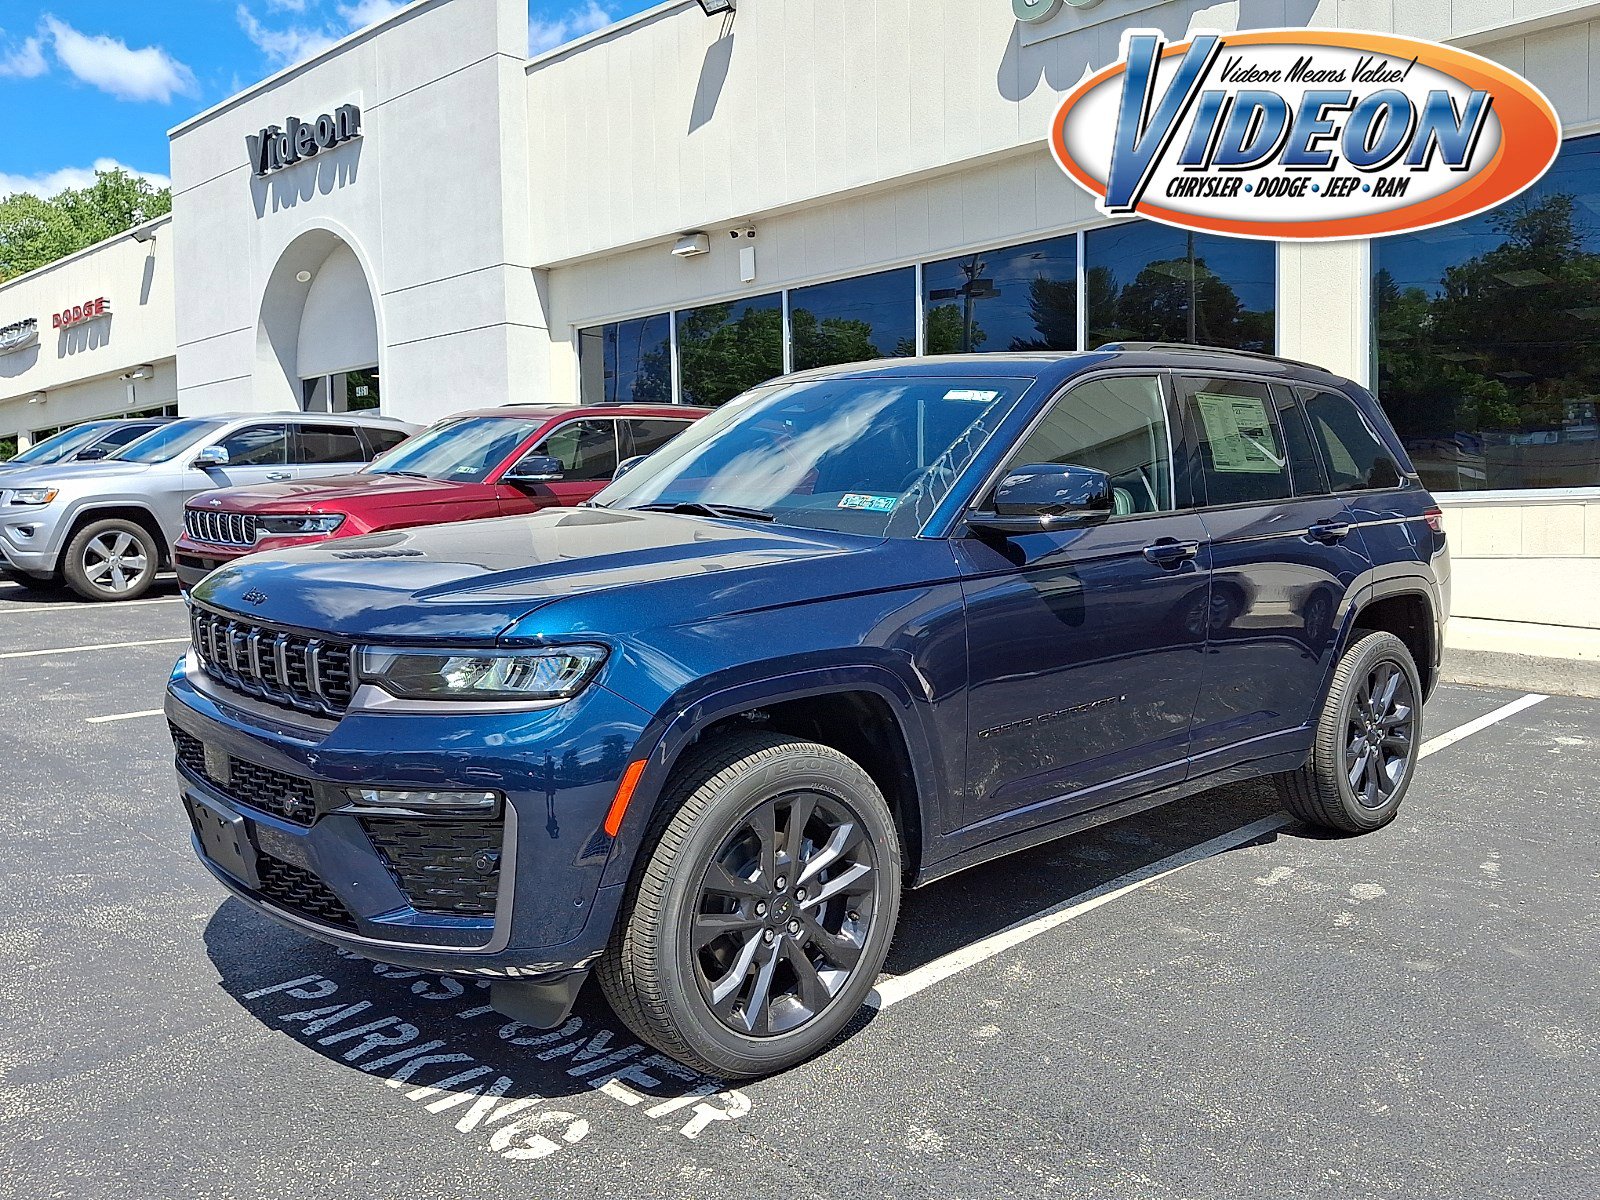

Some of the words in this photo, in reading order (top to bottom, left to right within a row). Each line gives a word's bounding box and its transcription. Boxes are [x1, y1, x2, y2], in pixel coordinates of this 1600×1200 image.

[245, 103, 361, 176] Videon
[52, 297, 111, 329] DODGE
[243, 974, 591, 1161] PARKING
